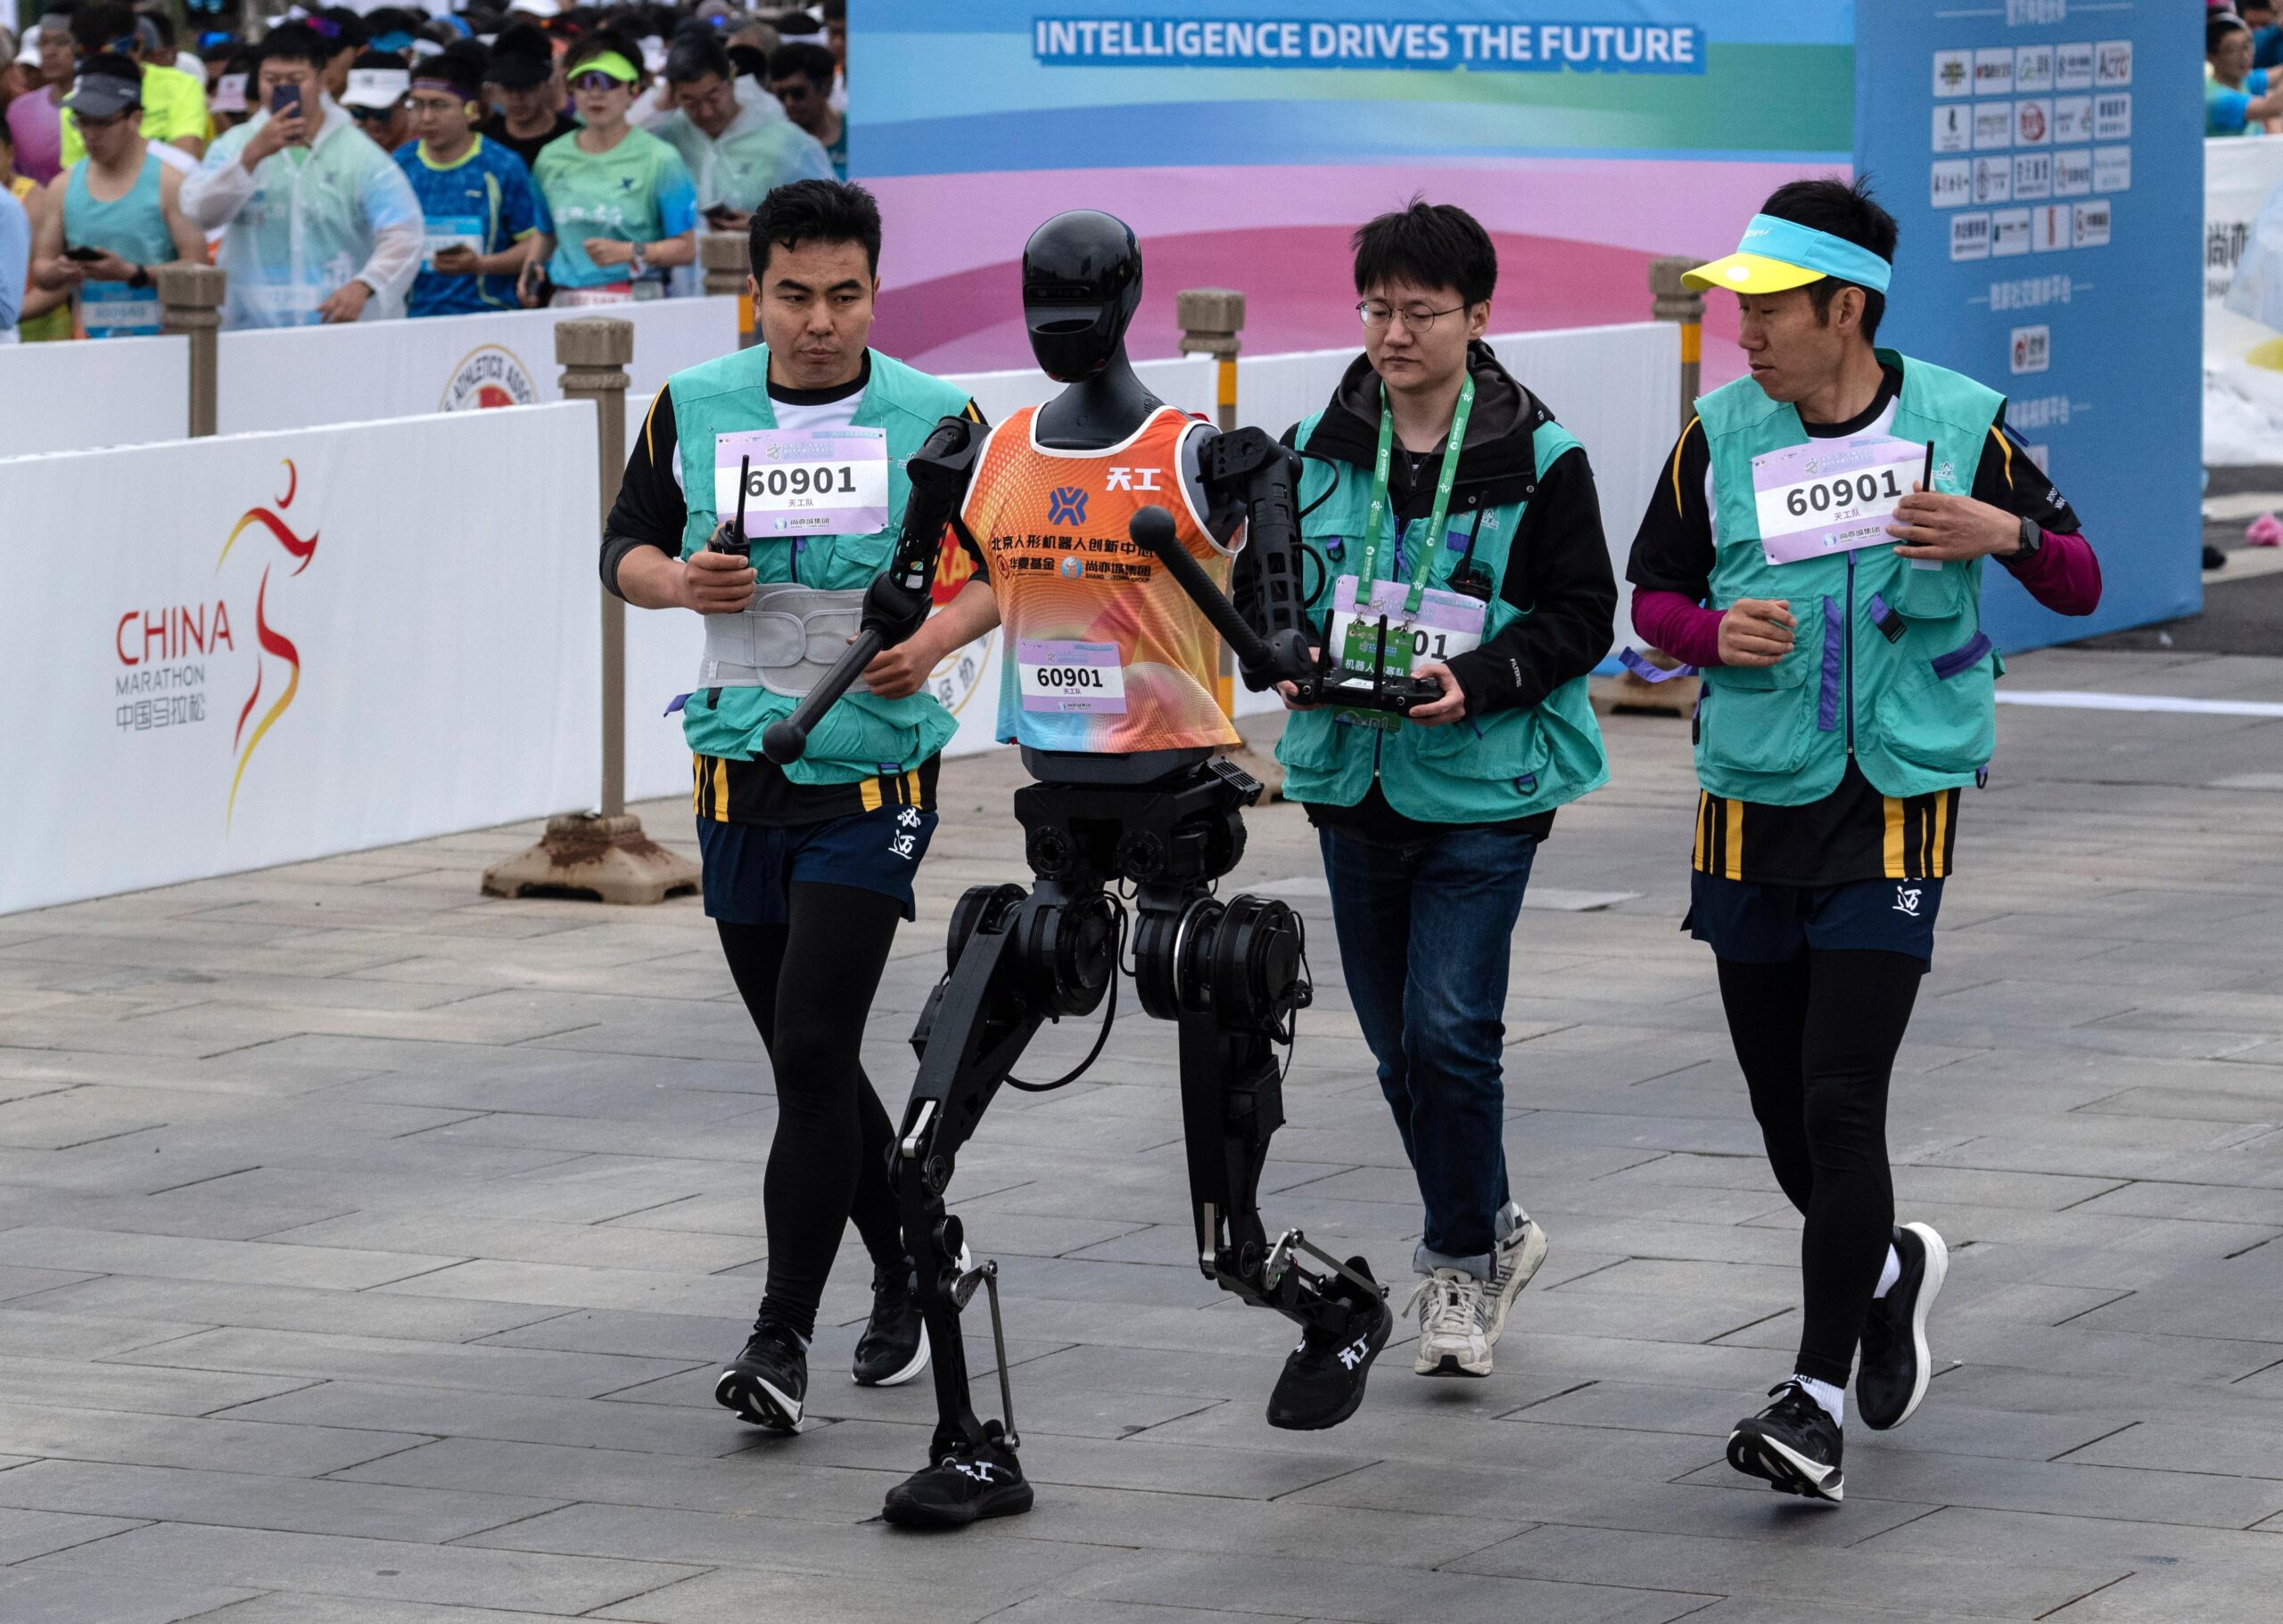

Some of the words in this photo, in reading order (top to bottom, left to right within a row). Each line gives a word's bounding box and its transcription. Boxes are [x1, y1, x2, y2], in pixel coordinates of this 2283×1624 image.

[1036, 21, 1302, 56] INTELLIGENCE
[1309, 22, 1449, 60] DRIVES
[1456, 25, 1532, 60] THE
[1540, 27, 1694, 62] FUTURE
[746, 466, 856, 497] 60901
[1106, 466, 1161, 490] 天工
[1786, 469, 1902, 516] 60901
[788, 498, 814, 507] 天工队
[1834, 508, 1861, 521] 天工队
[1010, 556, 1055, 571] 华夏基金
[1085, 560, 1151, 577] 尚亦城集团
[116, 599, 234, 665] CHINA
[115, 664, 205, 697] MARATHON
[1037, 667, 1103, 688] 60901
[1345, 658, 1405, 678] 机器人赛队
[116, 693, 205, 731] 中国马拉松
[1892, 878, 1923, 917] 迈
[1337, 1331, 1370, 1371] 天工
